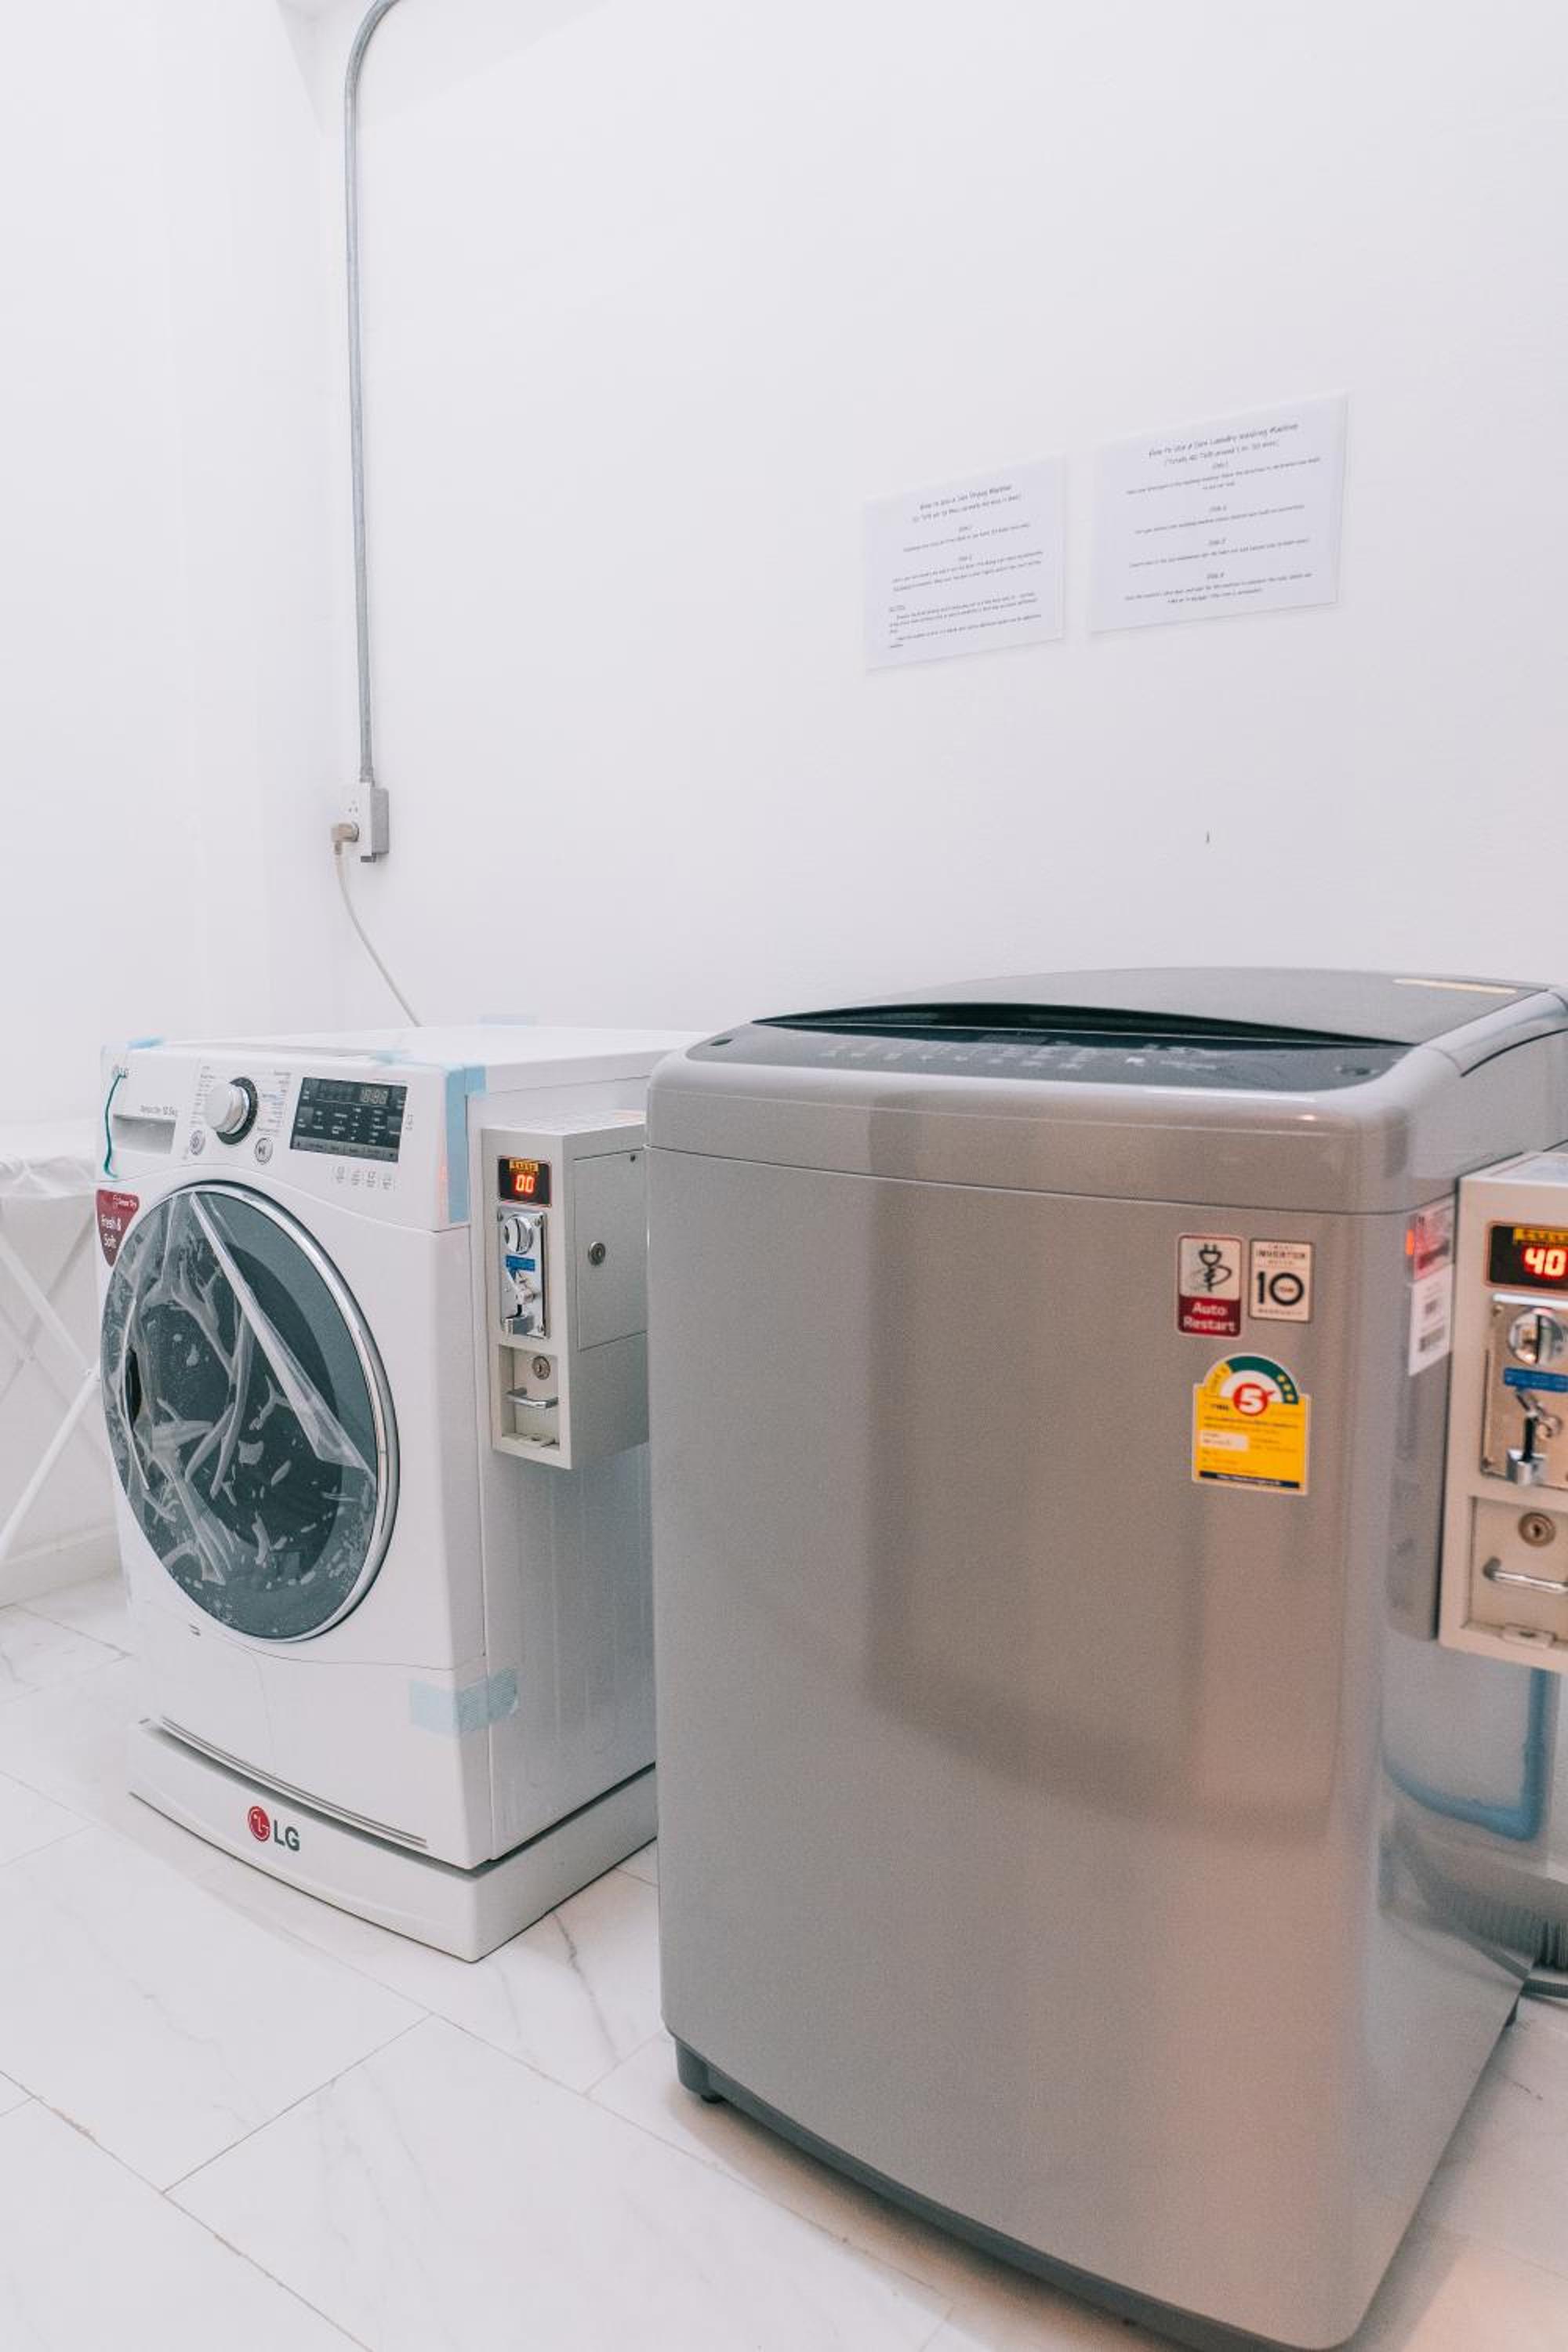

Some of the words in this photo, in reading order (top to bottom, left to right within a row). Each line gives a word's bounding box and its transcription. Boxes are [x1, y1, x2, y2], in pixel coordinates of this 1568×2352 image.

[1524, 1247, 1567, 1276] 40
[1257, 1270, 1305, 1307] 10
[1192, 1301, 1229, 1316] Auto
[1182, 1315, 1236, 1333] Restart
[1238, 1385, 1265, 1415] 5
[274, 1819, 300, 1852] LG
